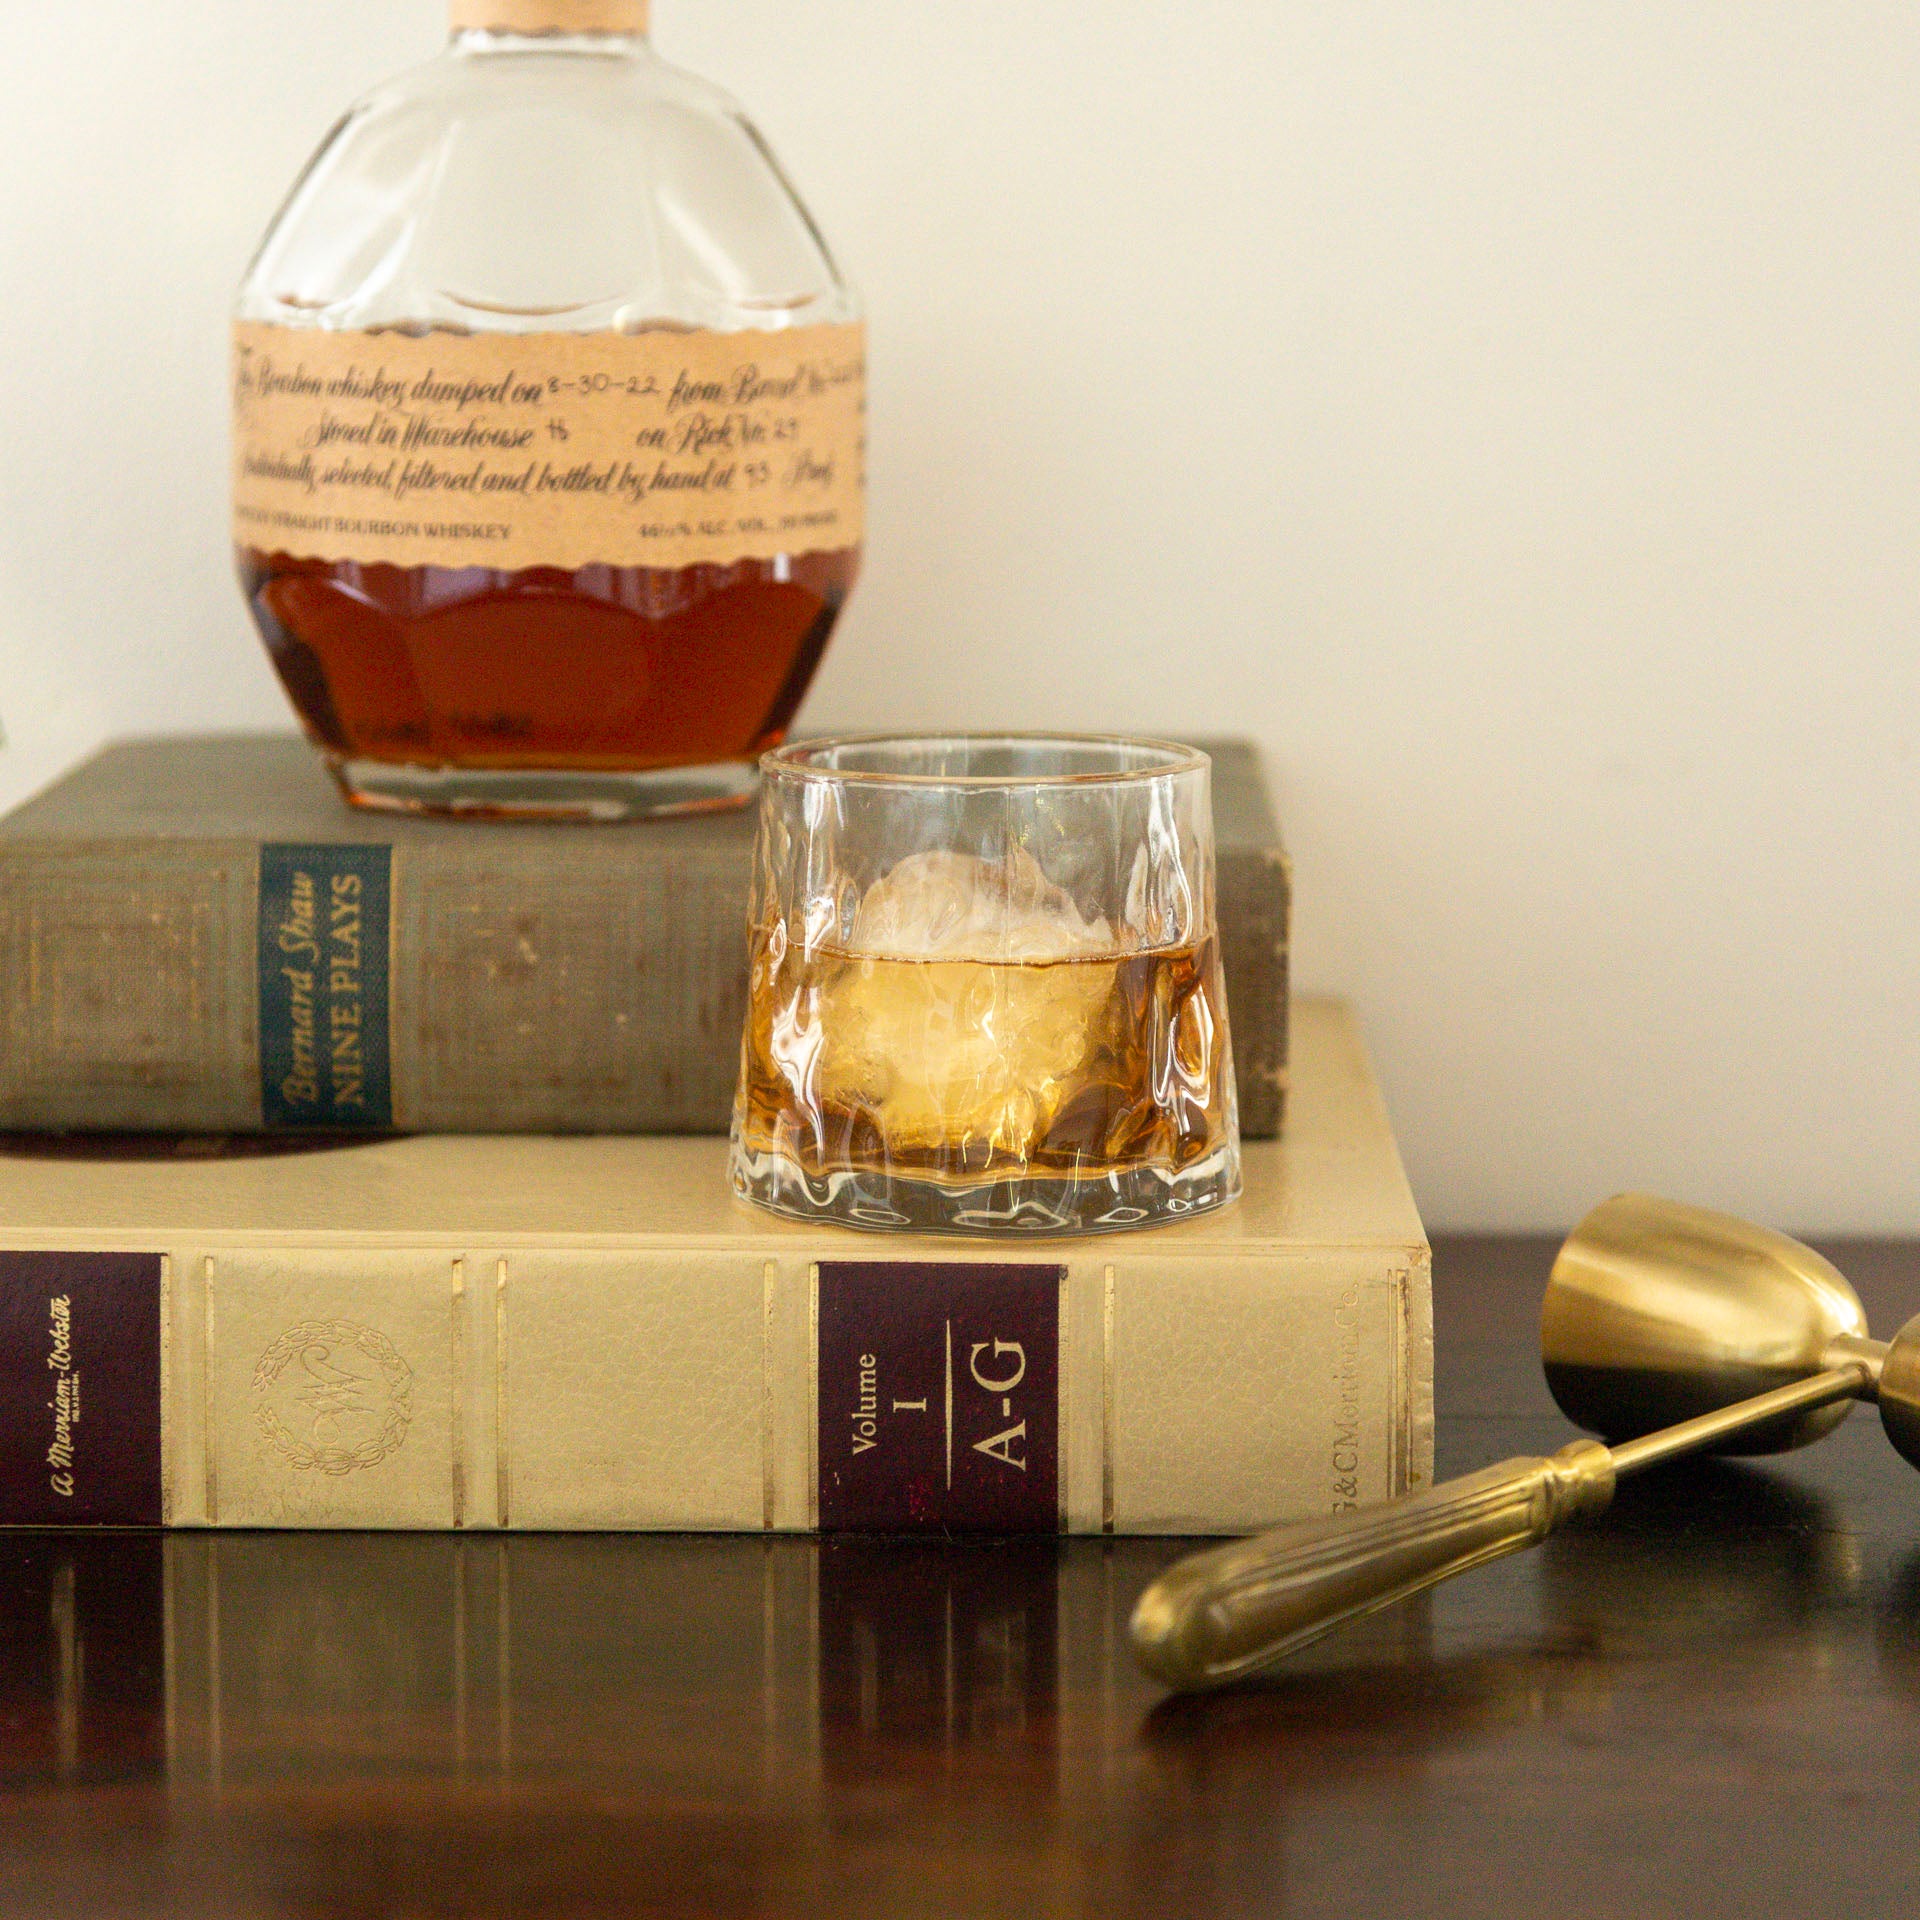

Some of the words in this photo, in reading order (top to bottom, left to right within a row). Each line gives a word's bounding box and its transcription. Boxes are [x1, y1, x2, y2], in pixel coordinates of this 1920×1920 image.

[327, 364, 407, 411] whiskey
[411, 367, 509, 412] dumped
[508, 379, 544, 406] on
[666, 368, 725, 415] from
[377, 420, 398, 446] in
[400, 414, 535, 451] Warehouse
[635, 425, 667, 449] on
[334, 517, 419, 538] BOURBON
[423, 521, 513, 541] WHISKEY
[393, 458, 484, 501] filtered
[481, 461, 537, 495] and
[537, 461, 618, 494] bottled
[617, 461, 647, 504] by
[648, 457, 715, 493] hand
[712, 460, 738, 491] at
[277, 869, 322, 966] Shaw
[329, 873, 364, 994] PLAYS
[280, 967, 320, 1107] Bernard
[330, 1002, 364, 1108] NINE
[45, 1293, 76, 1469] Merriam-Webster
[851, 1352, 878, 1456] Volume
[892, 1397, 928, 1414] I
[969, 1336, 1027, 1473] A-G
